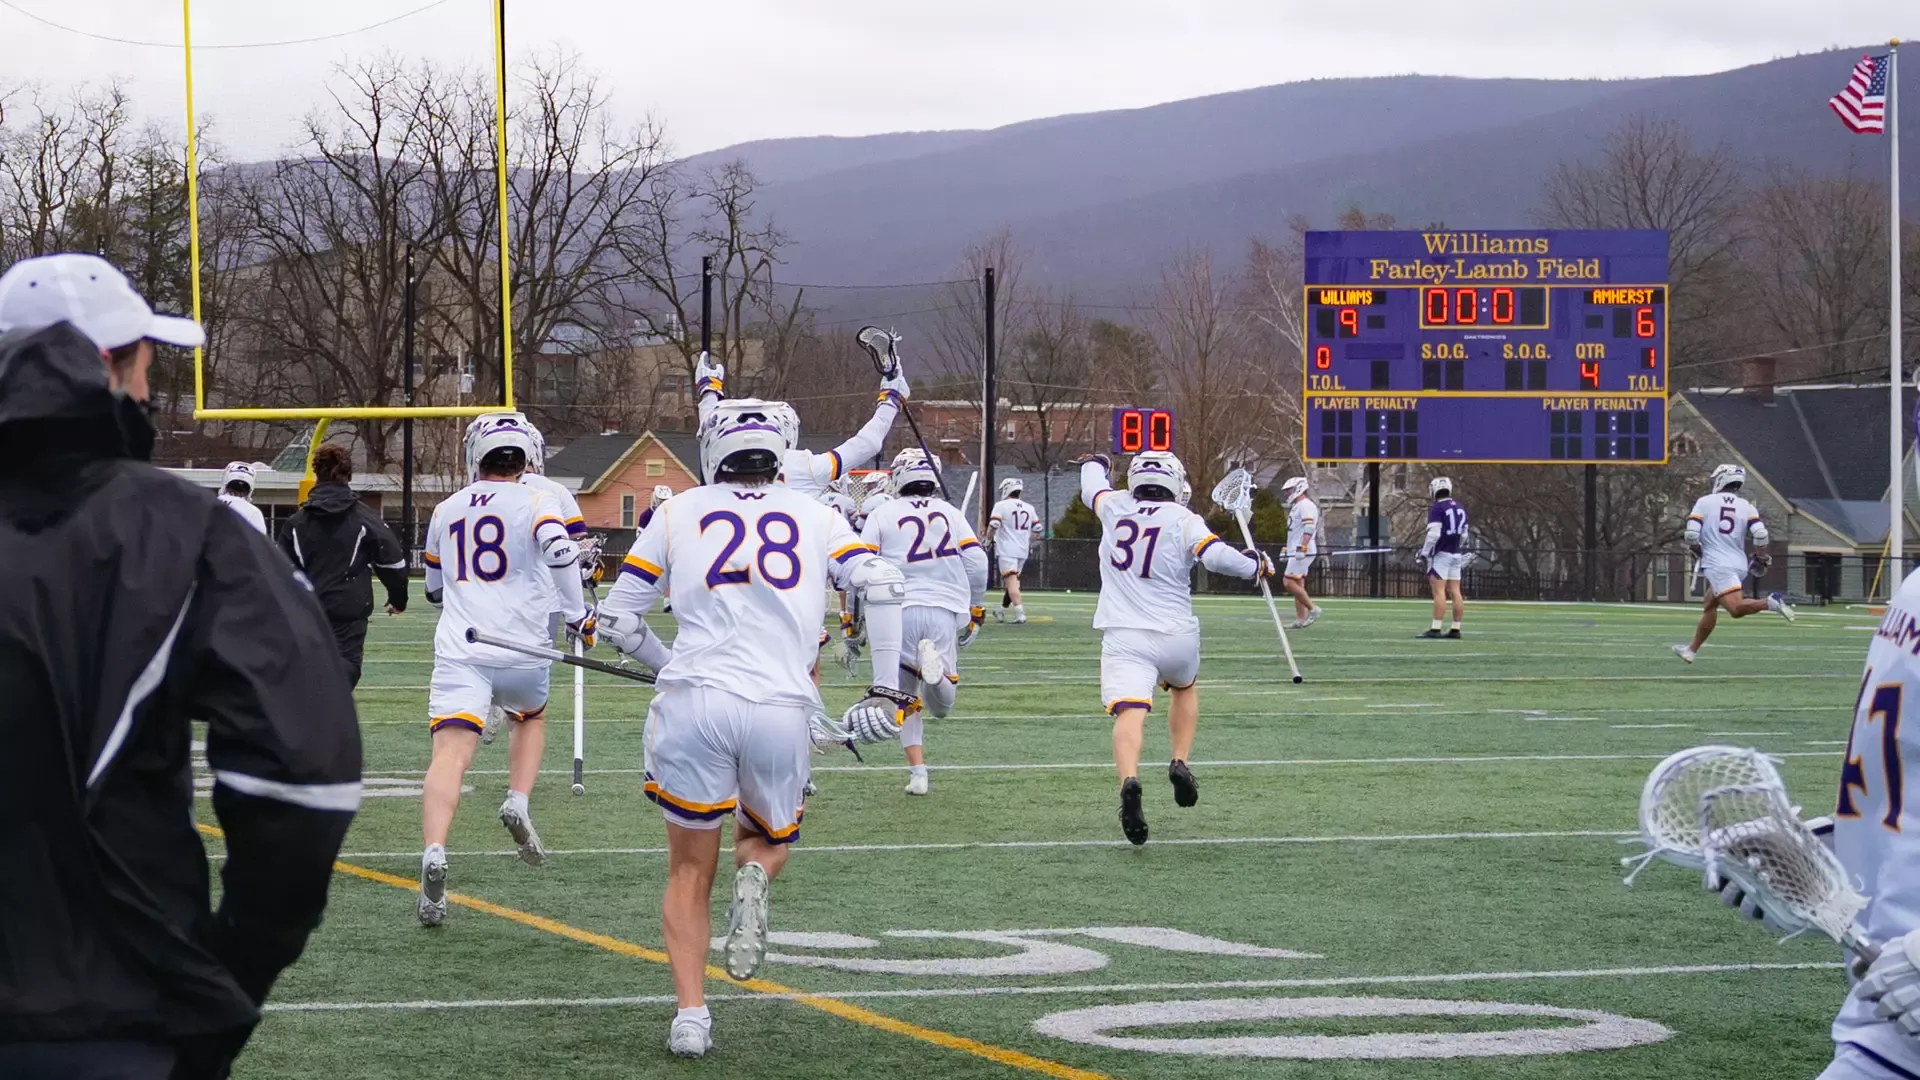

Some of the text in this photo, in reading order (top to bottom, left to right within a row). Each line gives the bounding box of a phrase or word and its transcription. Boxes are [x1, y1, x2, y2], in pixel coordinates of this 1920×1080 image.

[1422, 233, 1549, 254] Williams
[1370, 259, 1600, 285] Farley-Lamb Field
[1320, 290, 1373, 305] WILLIAMS
[1593, 289, 1654, 305] AMHERST
[1340, 308, 1358, 335] 9
[1636, 308, 1655, 337] 6
[1316, 346, 1331, 369] 0
[1421, 343, 1469, 360] S.O.G.
[1503, 343, 1552, 360] S.O.G.
[1575, 343, 1605, 360] QTR
[1310, 375, 1346, 391] T.O.L.
[1580, 361, 1600, 389] 4
[1628, 375, 1665, 392] T.O.L.
[1314, 397, 1418, 410] PLAYER PENALTY
[1543, 398, 1648, 411] PLAYER PENALTY
[1120, 411, 1172, 452] 80
[469, 492, 497, 508] W
[733, 491, 767, 502] W
[909, 499, 930, 510] W
[1011, 510, 1031, 531] 12
[1445, 507, 1468, 536] 12
[1717, 506, 1737, 535] 5
[897, 511, 960, 564] 22
[449, 513, 509, 584] 18
[553, 546, 572, 559] STX
[697, 508, 804, 591] 28
[1110, 517, 1163, 580] 31
